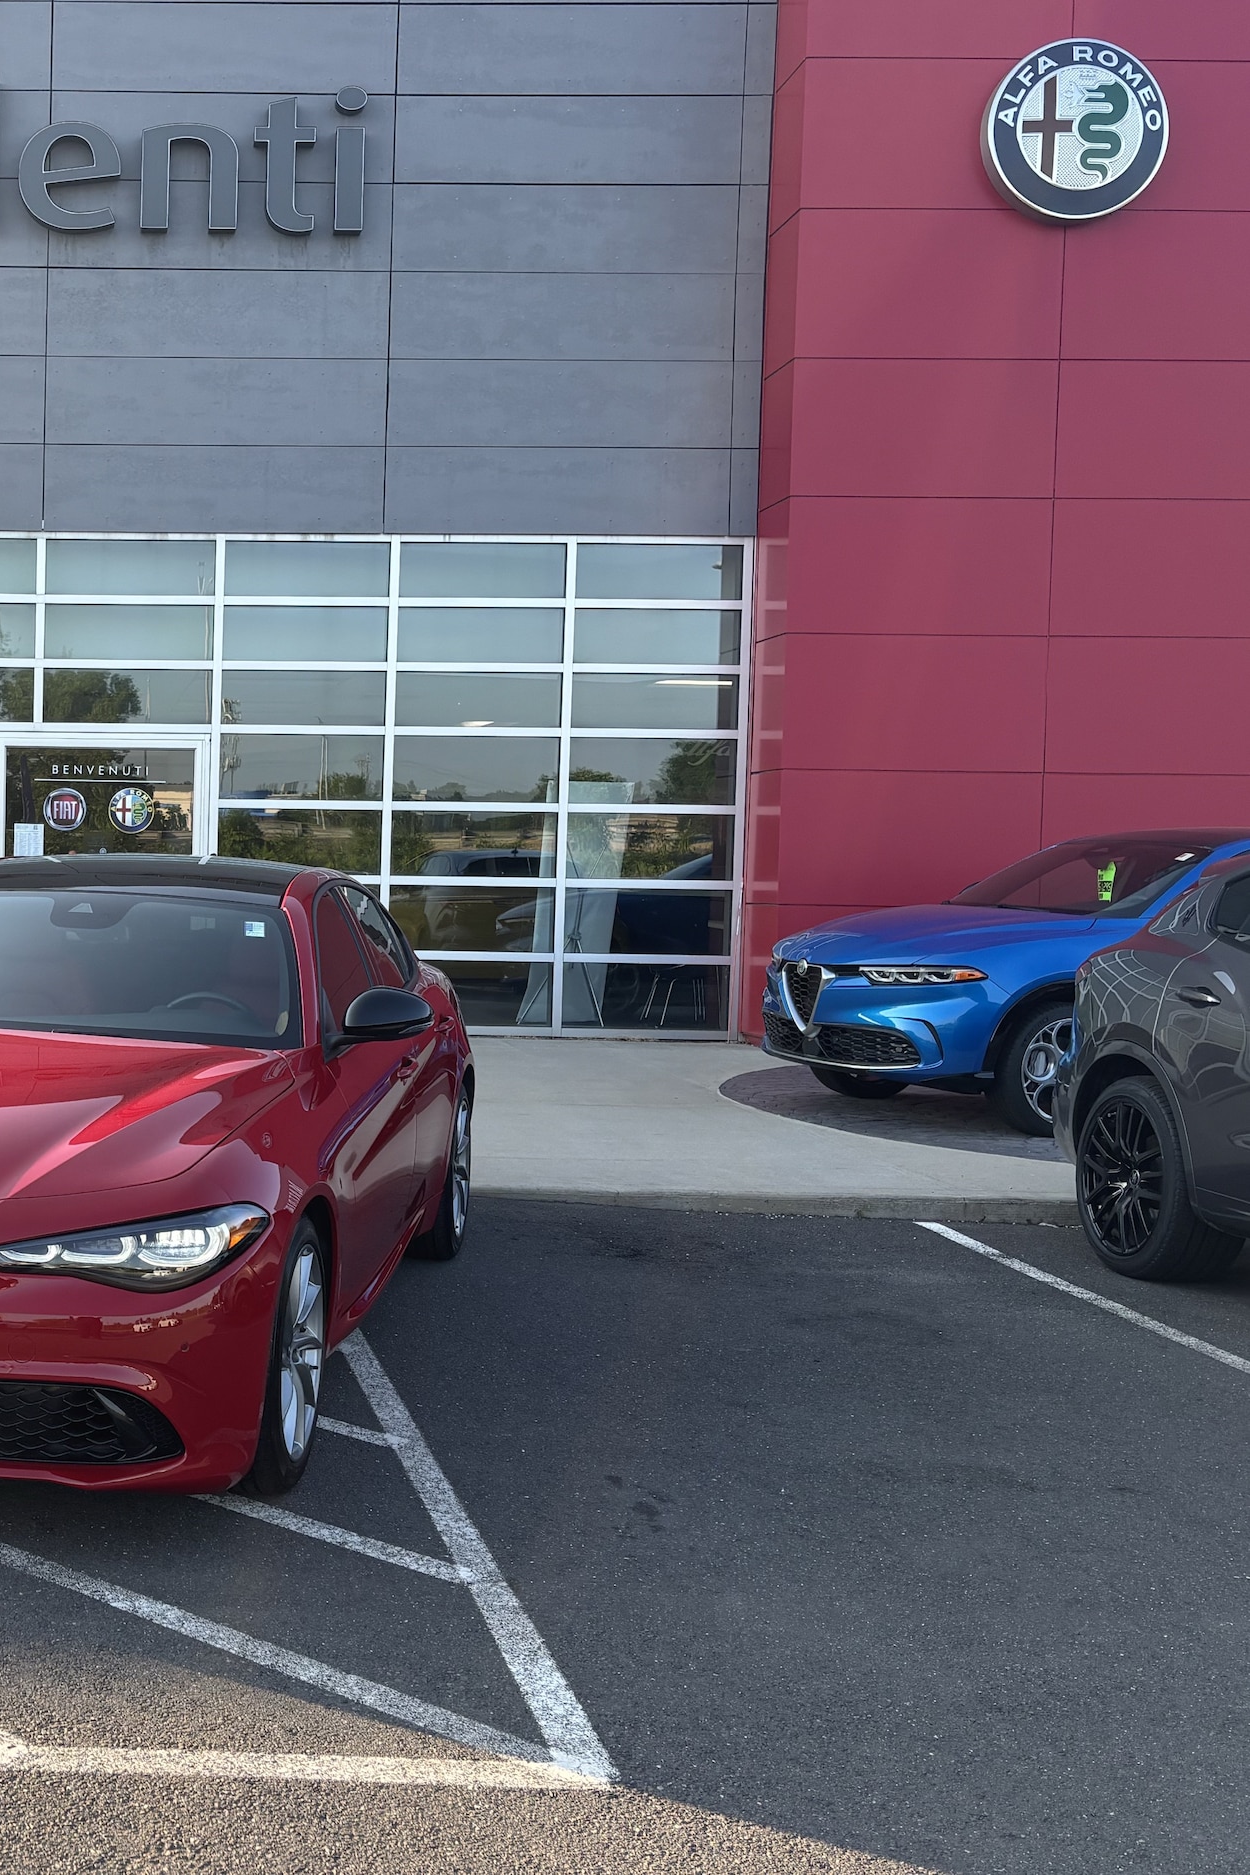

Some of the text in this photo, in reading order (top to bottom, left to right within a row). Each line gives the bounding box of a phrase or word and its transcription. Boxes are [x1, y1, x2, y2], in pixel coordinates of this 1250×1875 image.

[997, 45, 1162, 131] ALFA ROMEO
[51, 764, 149, 776] BENVENUTI
[53, 801, 78, 820] FIAT
[110, 789, 154, 813] ALFA ROMEO
